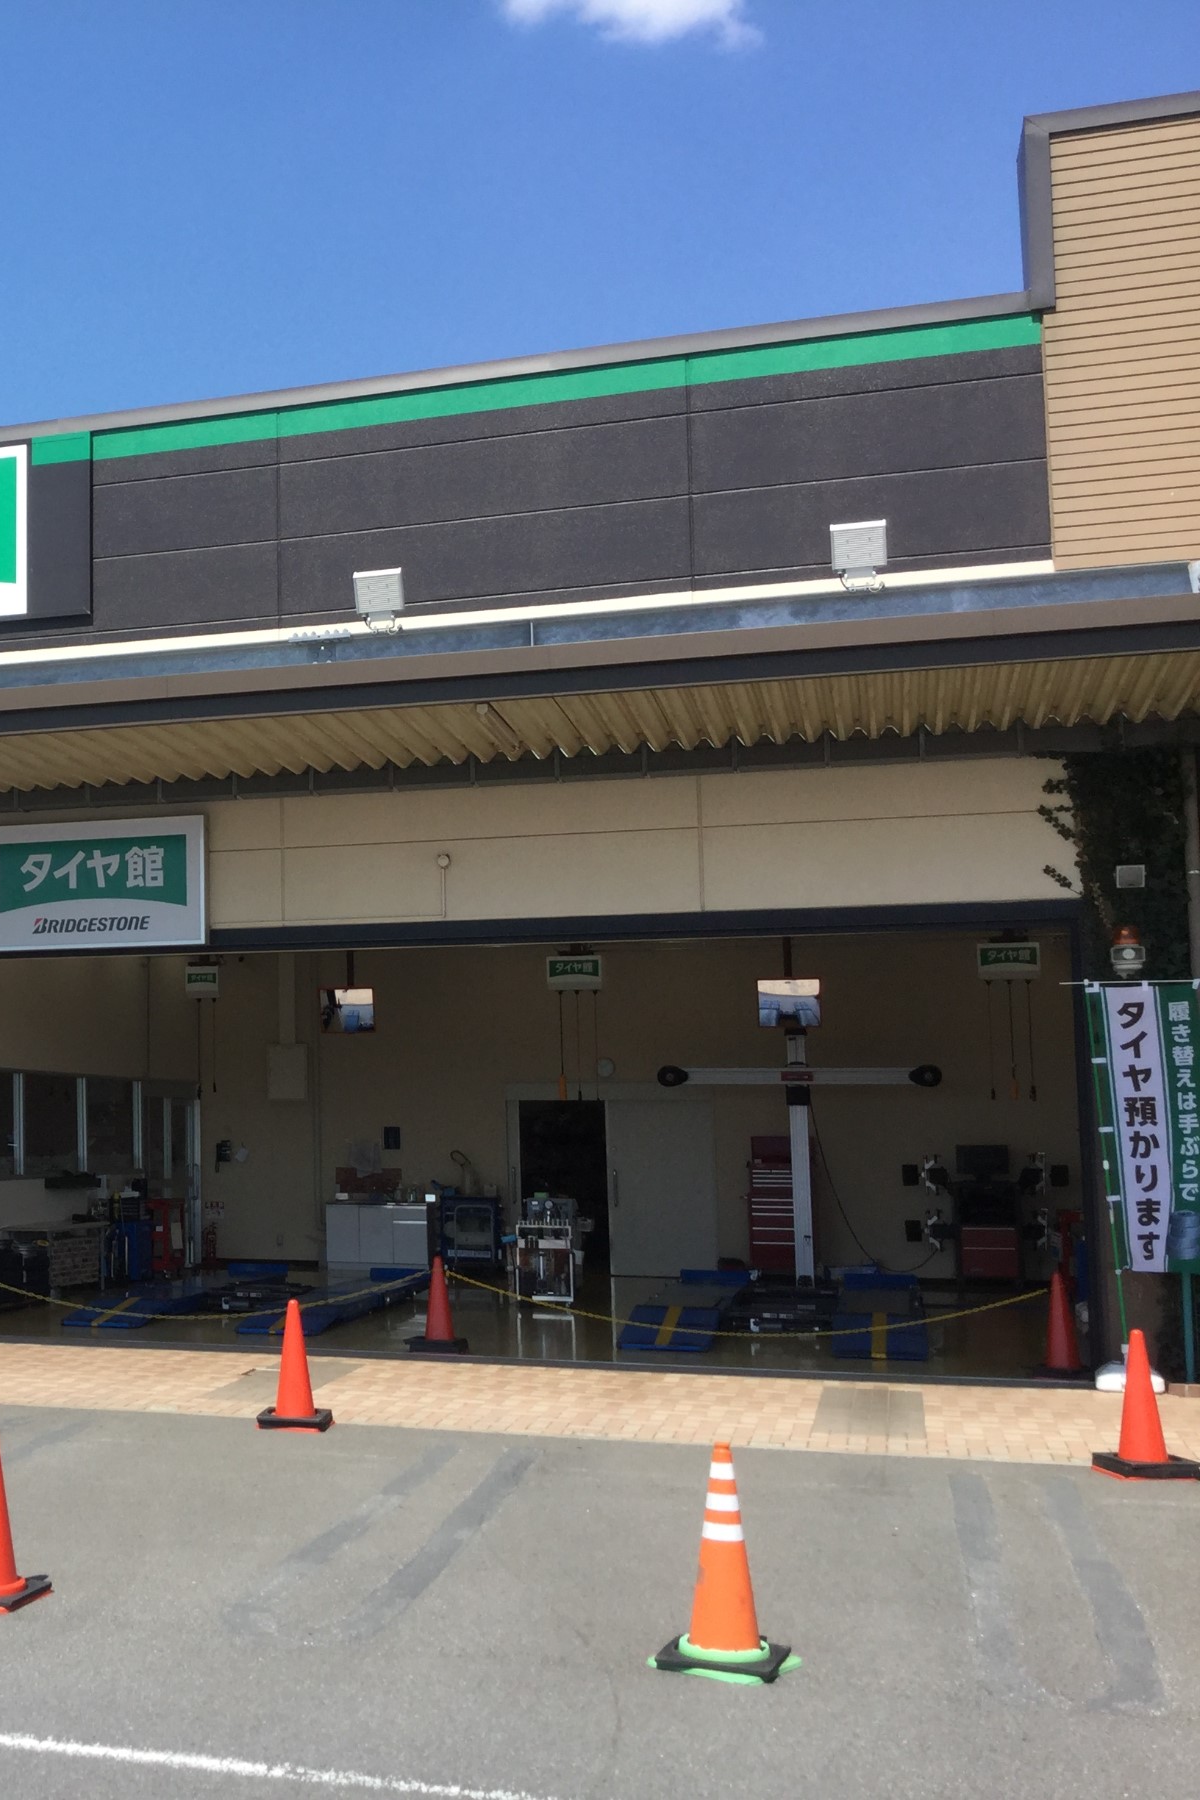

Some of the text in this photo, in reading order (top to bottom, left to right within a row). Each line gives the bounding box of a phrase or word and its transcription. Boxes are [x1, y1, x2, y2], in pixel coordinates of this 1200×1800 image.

[20, 845, 164, 892] タイヤ館
[32, 915, 151, 935] BRIDGESTONE
[555, 962, 593, 973] タイヤ館
[987, 949, 1031, 961] タイヤ館
[1168, 1000, 1200, 1201] 履き替えは手ぶらで
[1116, 1001, 1161, 1261] タイヤ預かります
